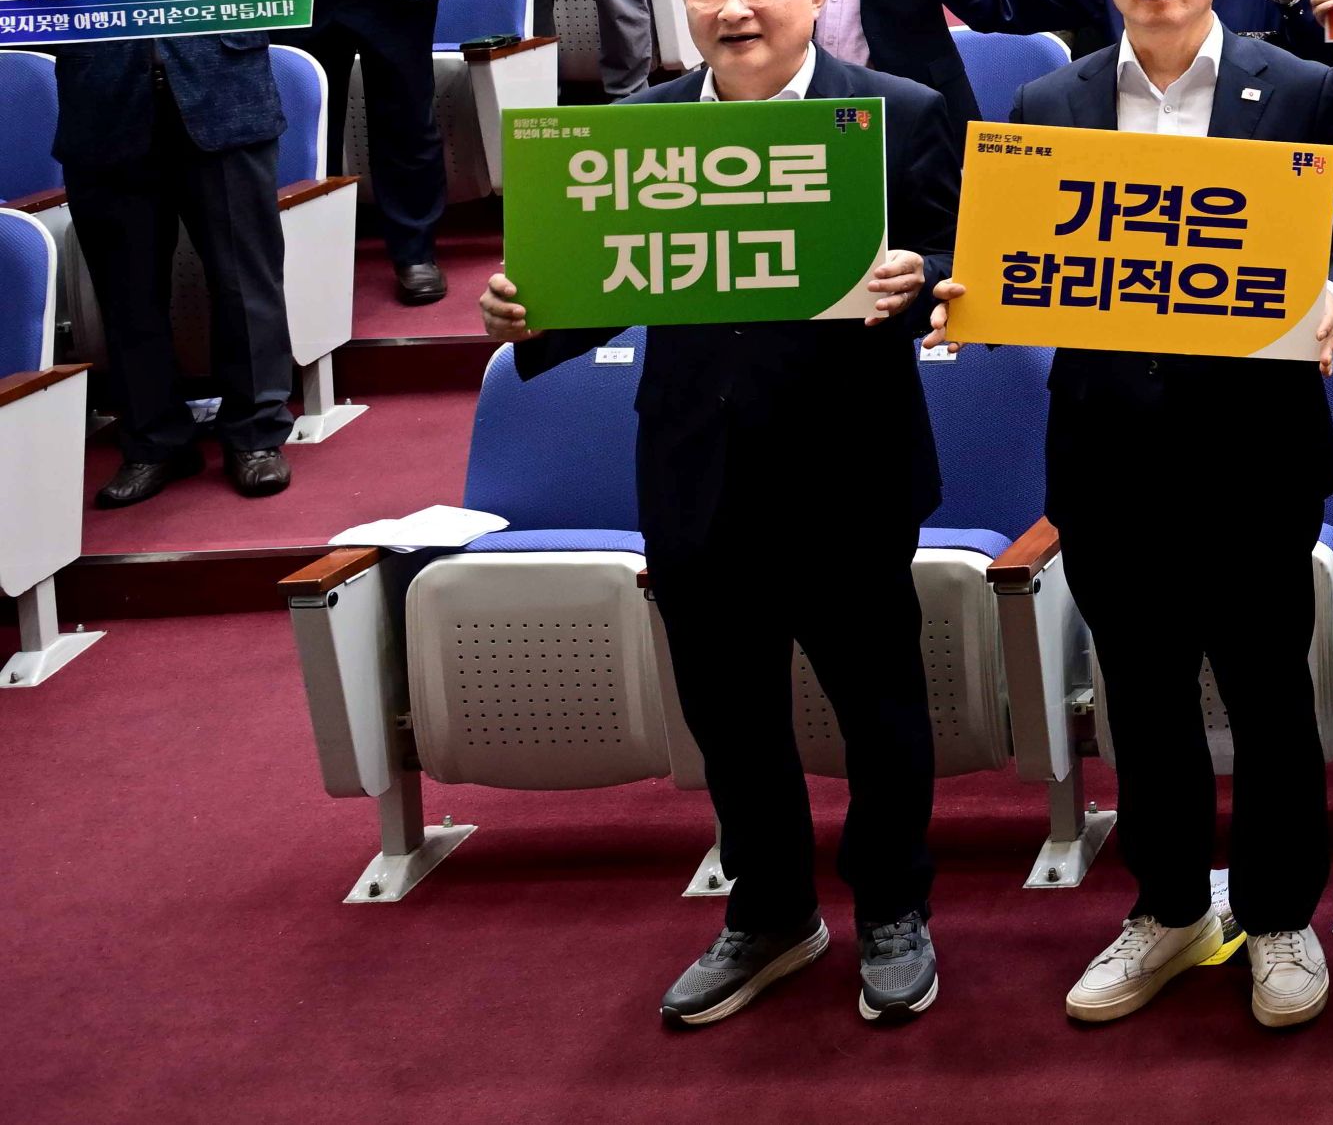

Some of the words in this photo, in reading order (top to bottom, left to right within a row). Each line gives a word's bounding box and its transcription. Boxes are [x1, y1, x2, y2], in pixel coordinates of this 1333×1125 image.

[1, 14, 70, 33] 잊지못할
[74, 11, 126, 29] 여행지
[133, 6, 217, 26] 우리손으로
[220, 0, 294, 19] 만듭시다!
[566, 144, 831, 211] 위생으로
[1292, 152, 1326, 177] 목포랑
[1055, 180, 1248, 249] 가격은
[603, 229, 799, 294] 지키고
[1001, 251, 1286, 319] 합리적으로
